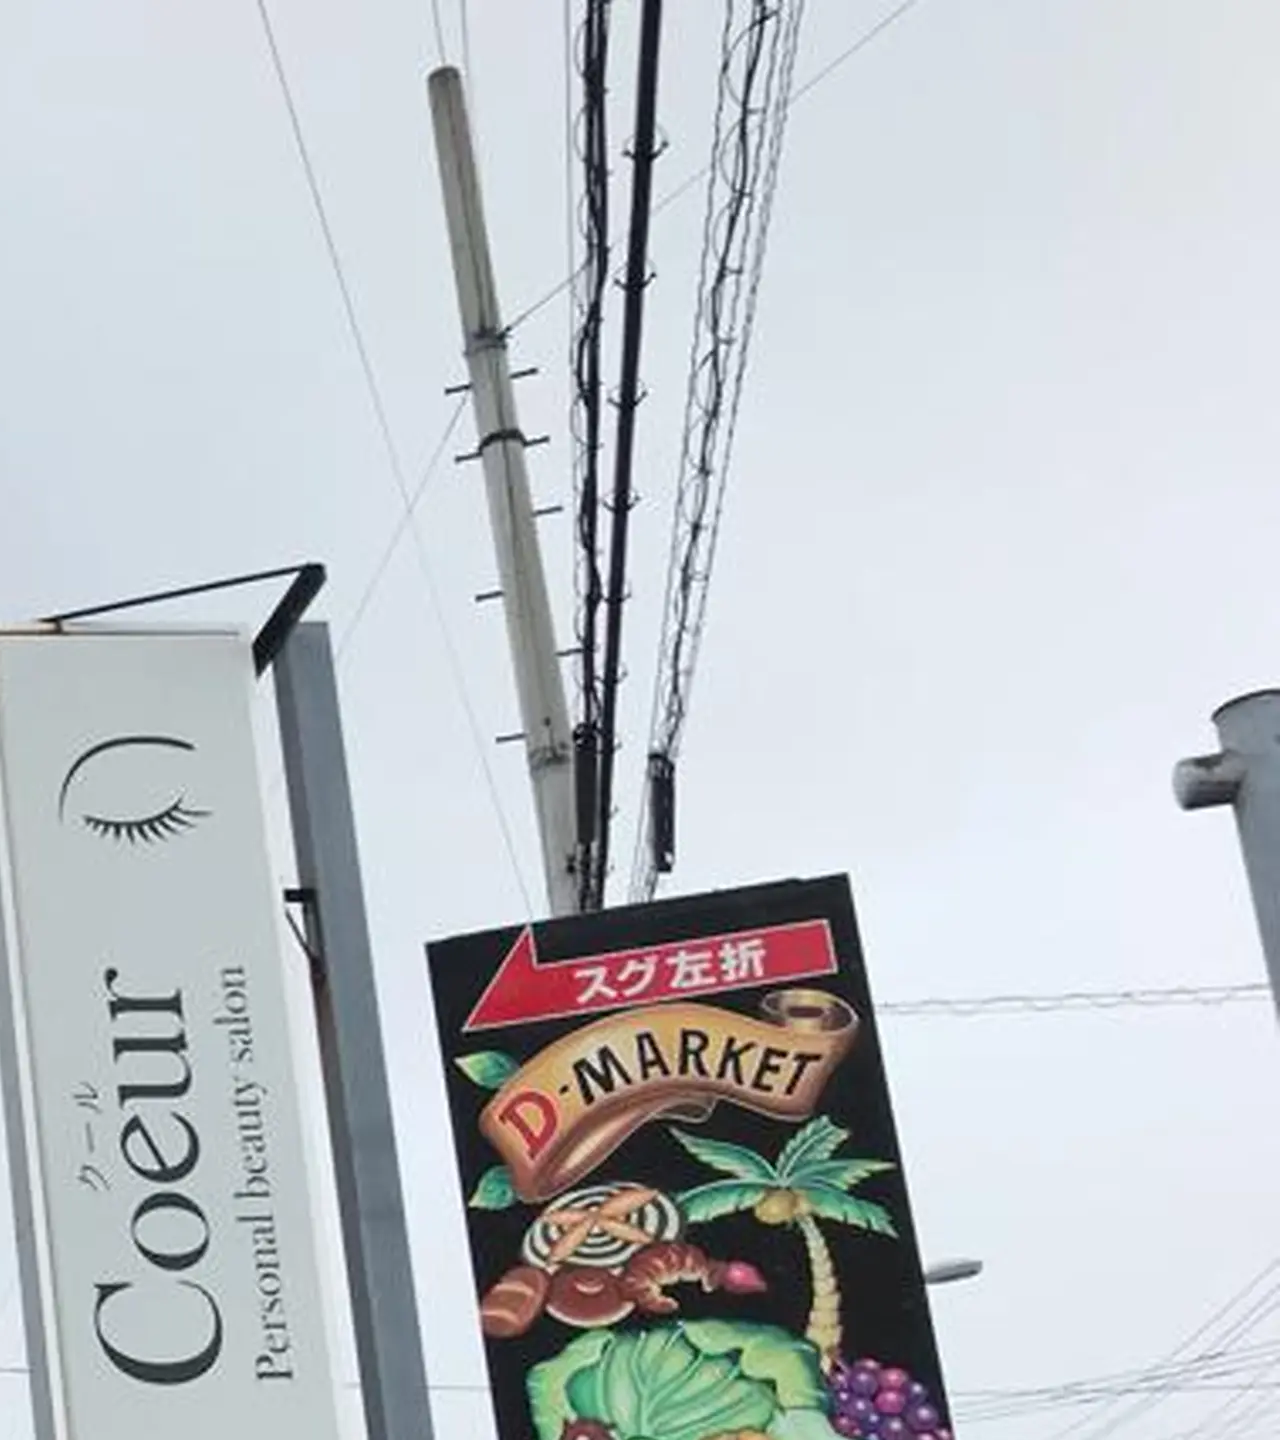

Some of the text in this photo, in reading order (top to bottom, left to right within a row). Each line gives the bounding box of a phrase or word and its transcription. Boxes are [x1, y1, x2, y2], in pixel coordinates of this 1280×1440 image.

[573, 938, 767, 1004] スグ左折
[74, 1080, 113, 1193] クール
[498, 1027, 824, 1162] D-MARKET
[93, 966, 224, 1386] Coeur
[213, 965, 294, 1382] Personal beauty salon
